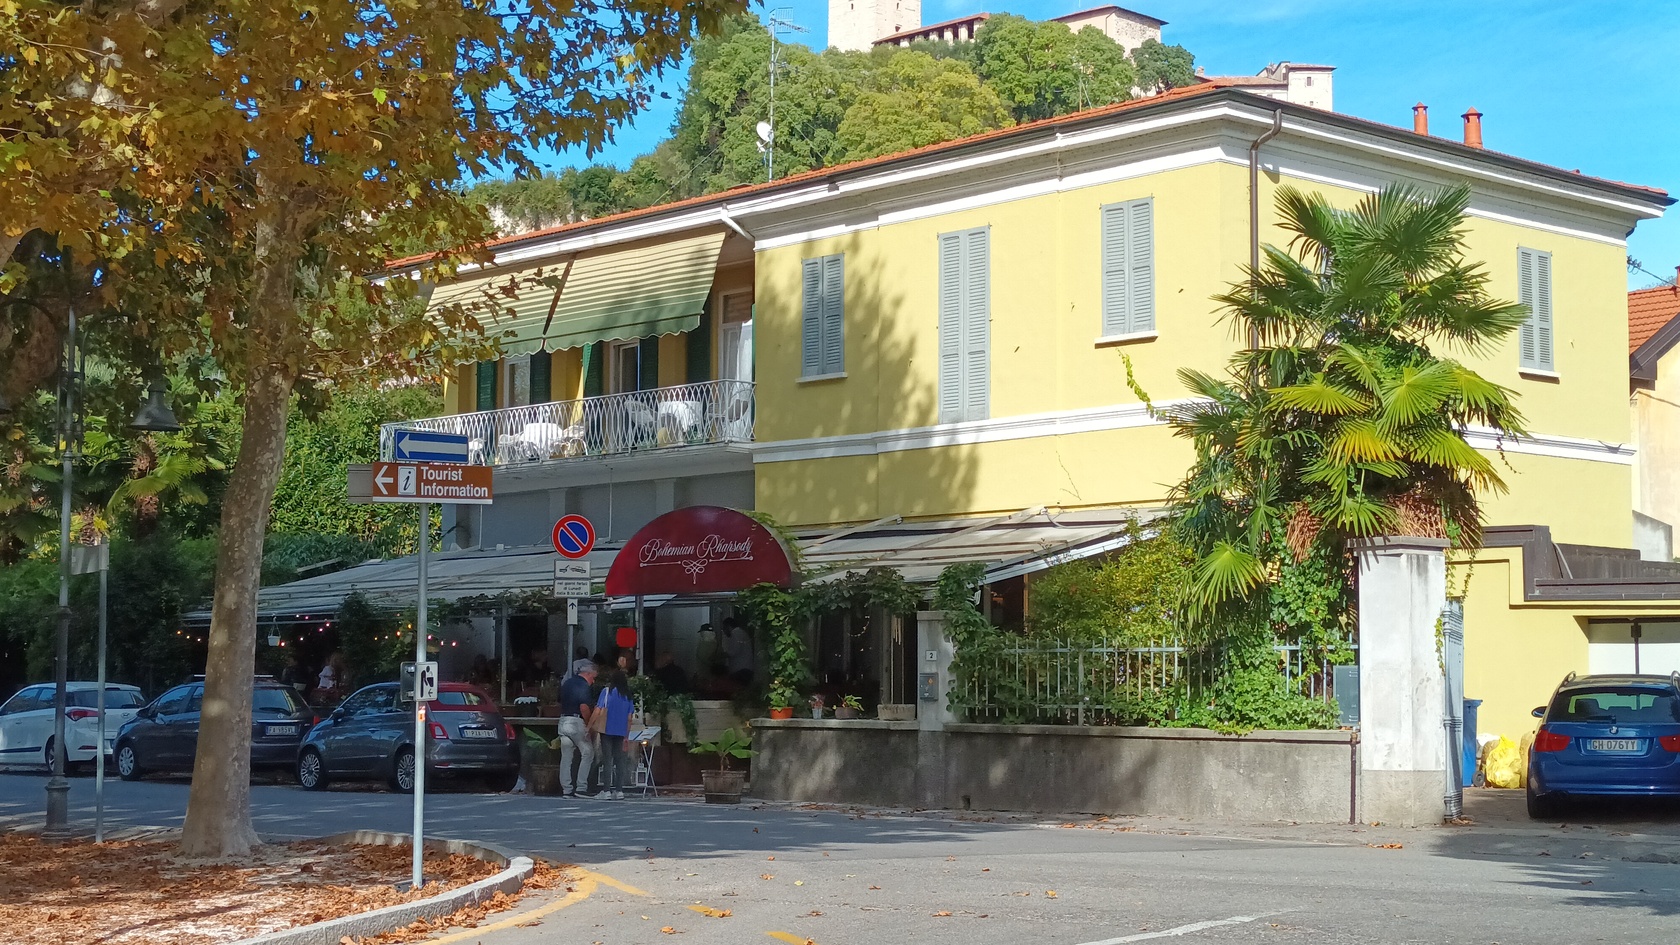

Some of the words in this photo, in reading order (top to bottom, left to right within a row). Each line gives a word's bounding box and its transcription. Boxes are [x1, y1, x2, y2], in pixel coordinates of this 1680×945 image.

[421, 466, 462, 481] Tourist
[420, 482, 488, 497] Information
[639, 538, 695, 562] Bohemian
[697, 534, 753, 560] Rhapsody
[1606, 740, 1636, 750] 076YY
